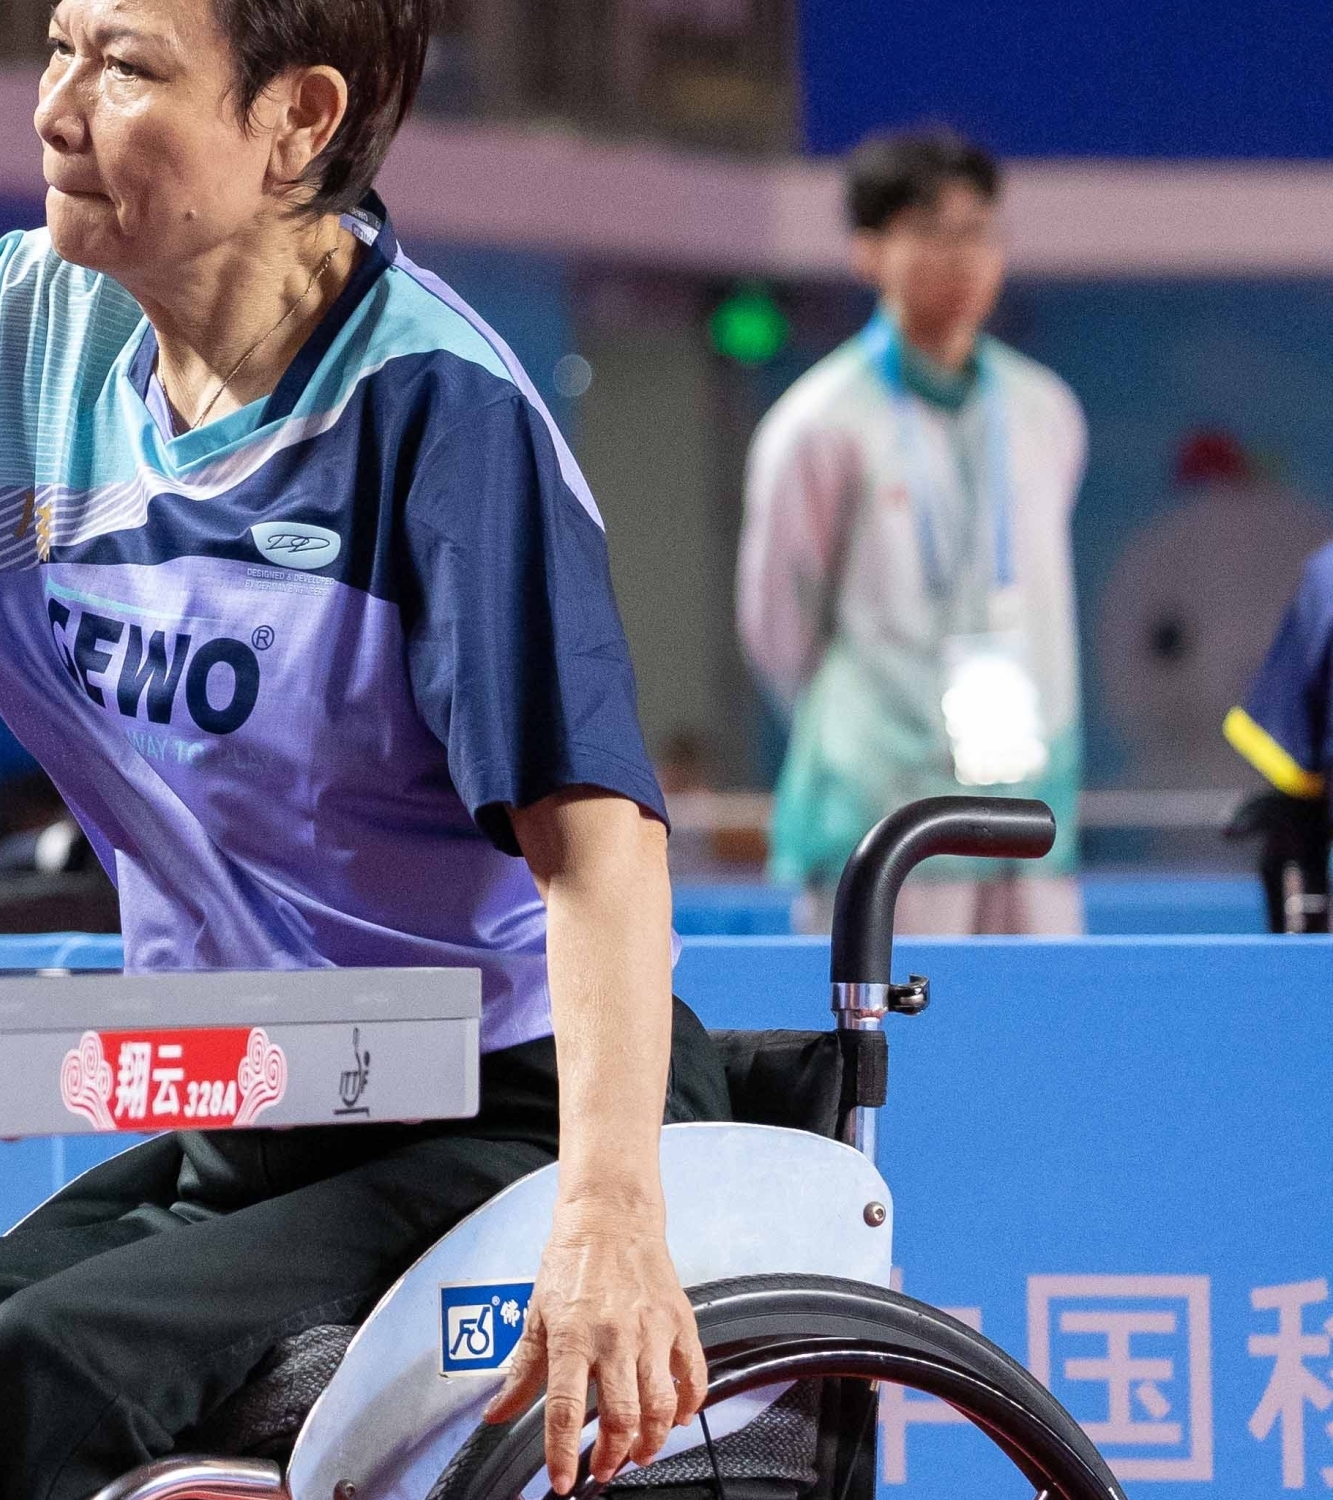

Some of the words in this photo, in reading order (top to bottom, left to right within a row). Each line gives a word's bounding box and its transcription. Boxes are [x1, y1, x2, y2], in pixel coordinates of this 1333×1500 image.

[247, 568, 285, 580] DESIGNED
[114, 1042, 186, 1120] 翔云
[183, 1079, 238, 1118] 328A
